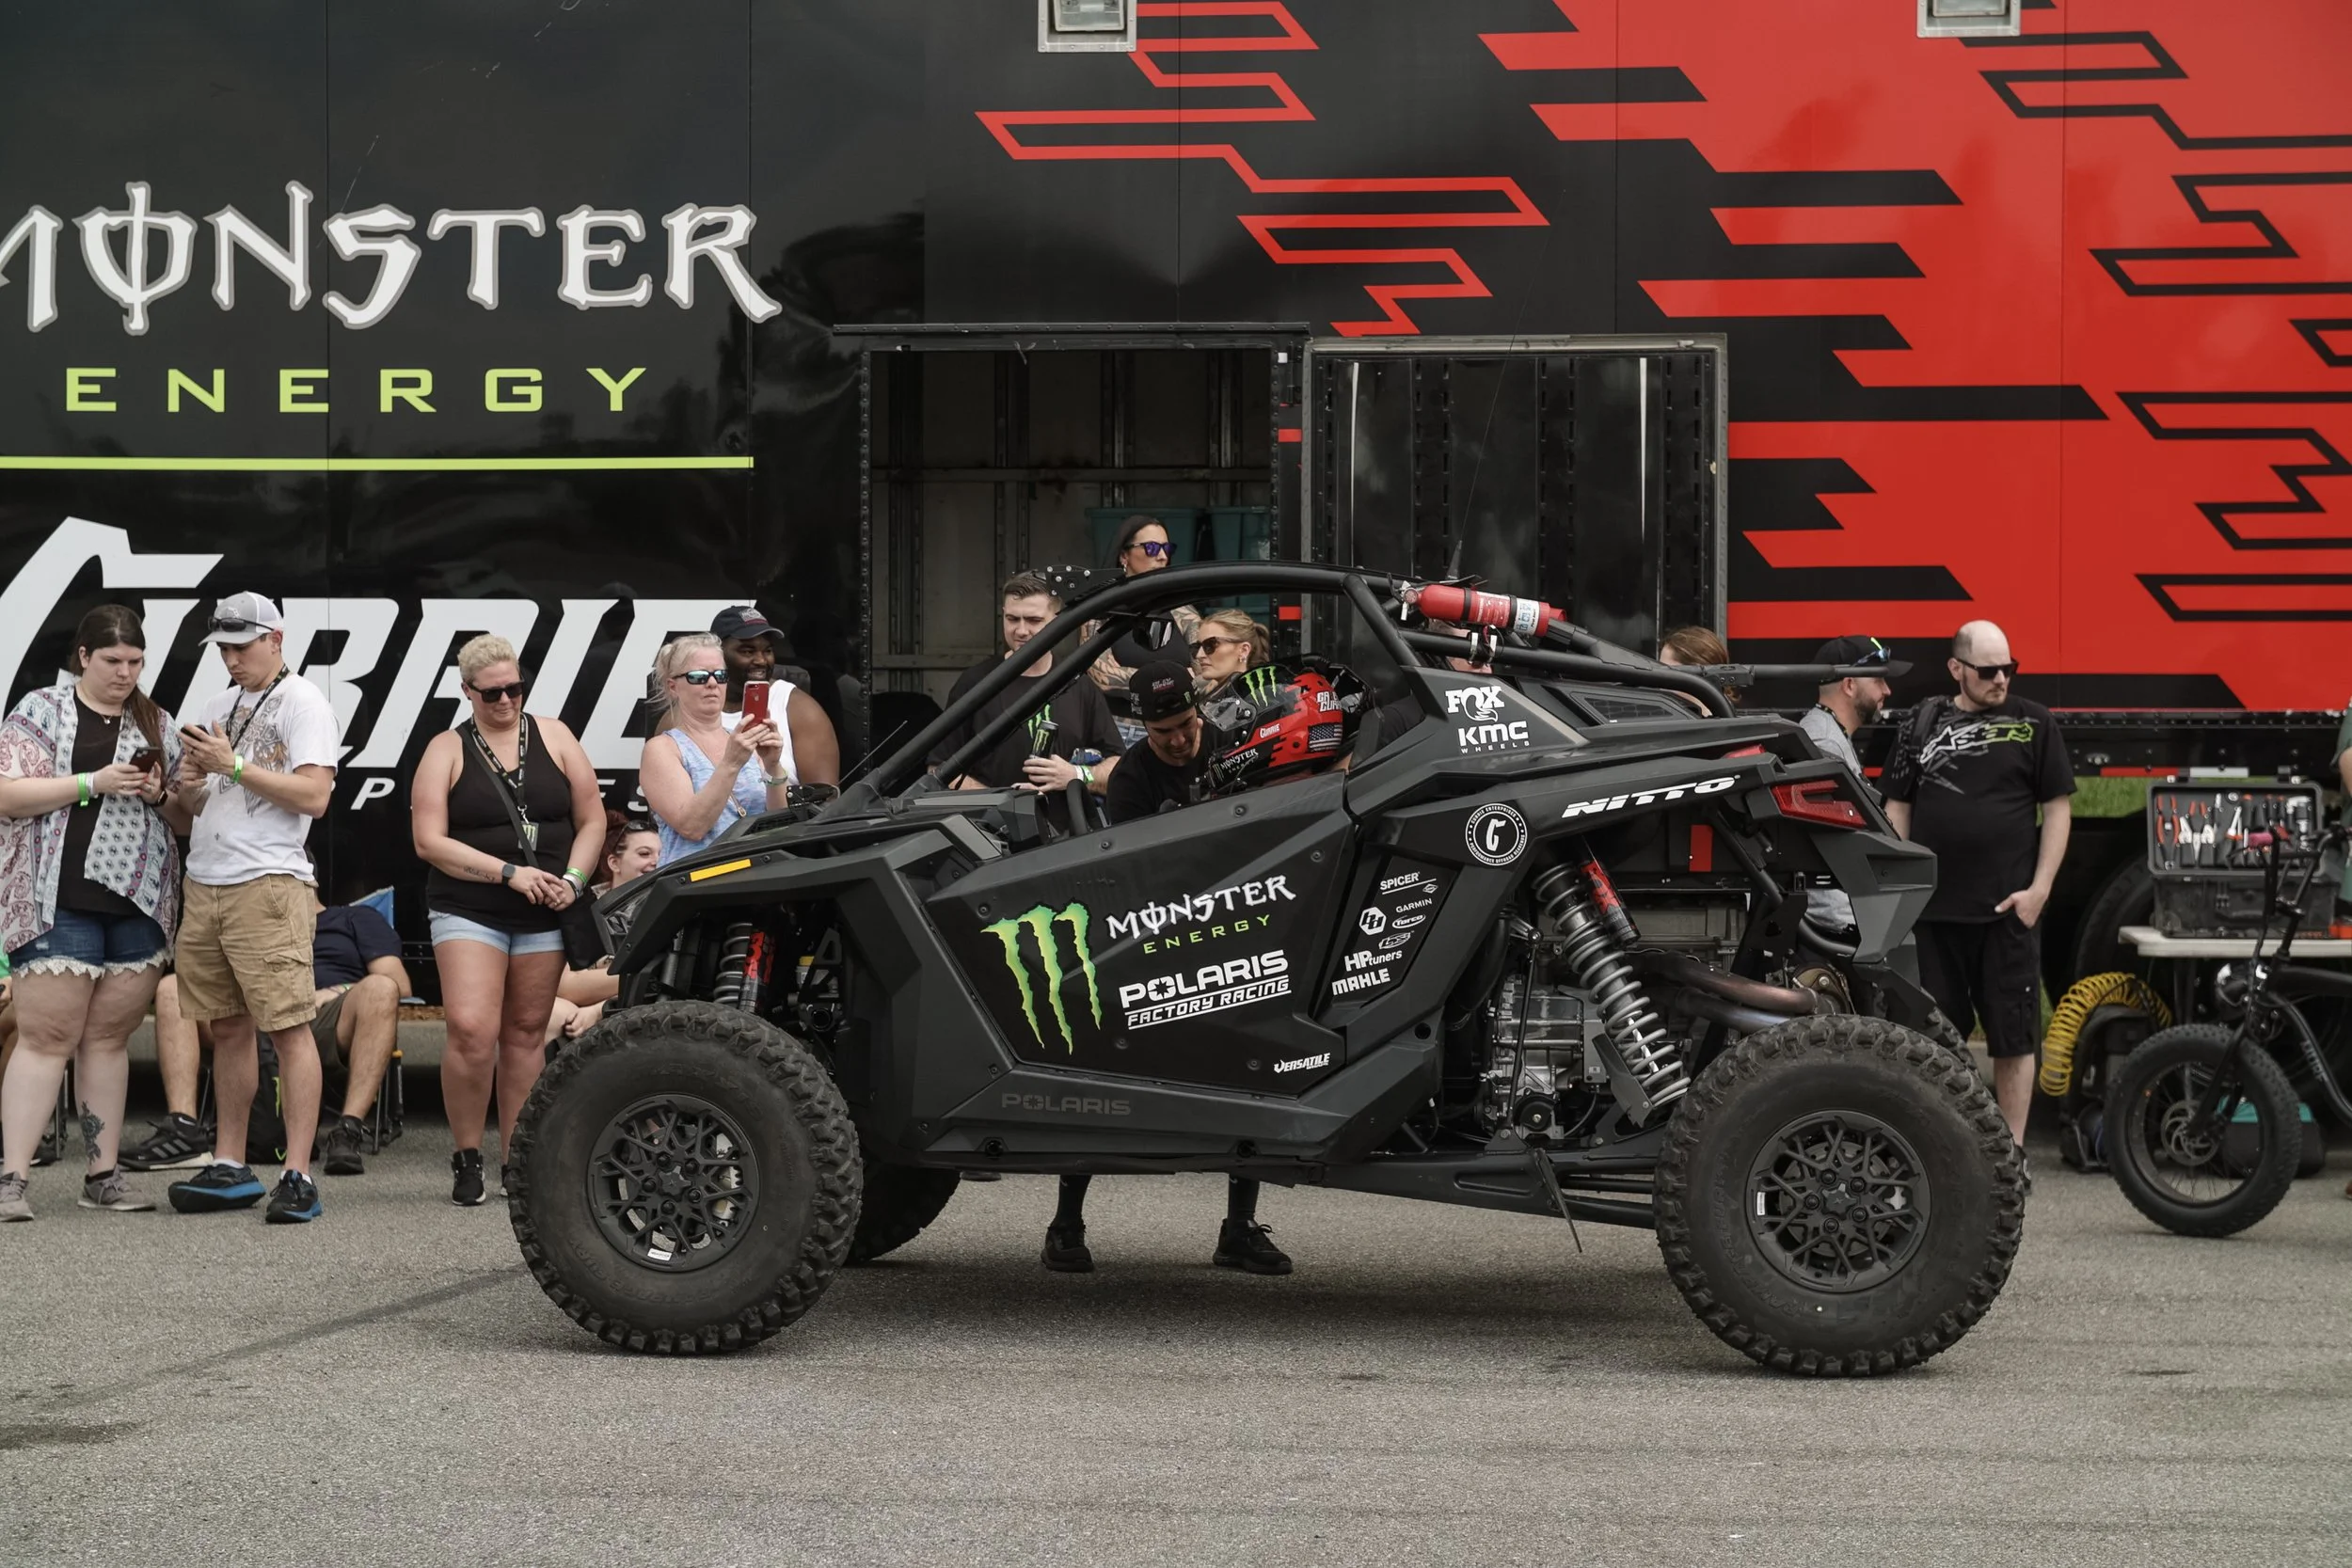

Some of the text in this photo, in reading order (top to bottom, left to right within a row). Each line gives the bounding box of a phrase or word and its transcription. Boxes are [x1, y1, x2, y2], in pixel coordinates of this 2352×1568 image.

[66, 368, 646, 412] ENERGY
[1445, 686, 1504, 722] FOX
[1220, 748, 1259, 769] MONSTER
[1461, 740, 1530, 753] WHEELS
[1562, 777, 1735, 818] NITTO
[1380, 872, 1419, 891] SPICER
[1105, 875, 1296, 940] MONSTER
[1395, 898, 1433, 913] GARMIN
[1143, 914, 1270, 954] ENERGY
[1119, 949, 1289, 1008] POLARIS
[1332, 968, 1391, 995] MAHLE
[1128, 978, 1290, 1026] FACTORY RACING
[1273, 1053, 1331, 1073] VERSATILE
[1002, 1093, 1131, 1116] POLARIS
